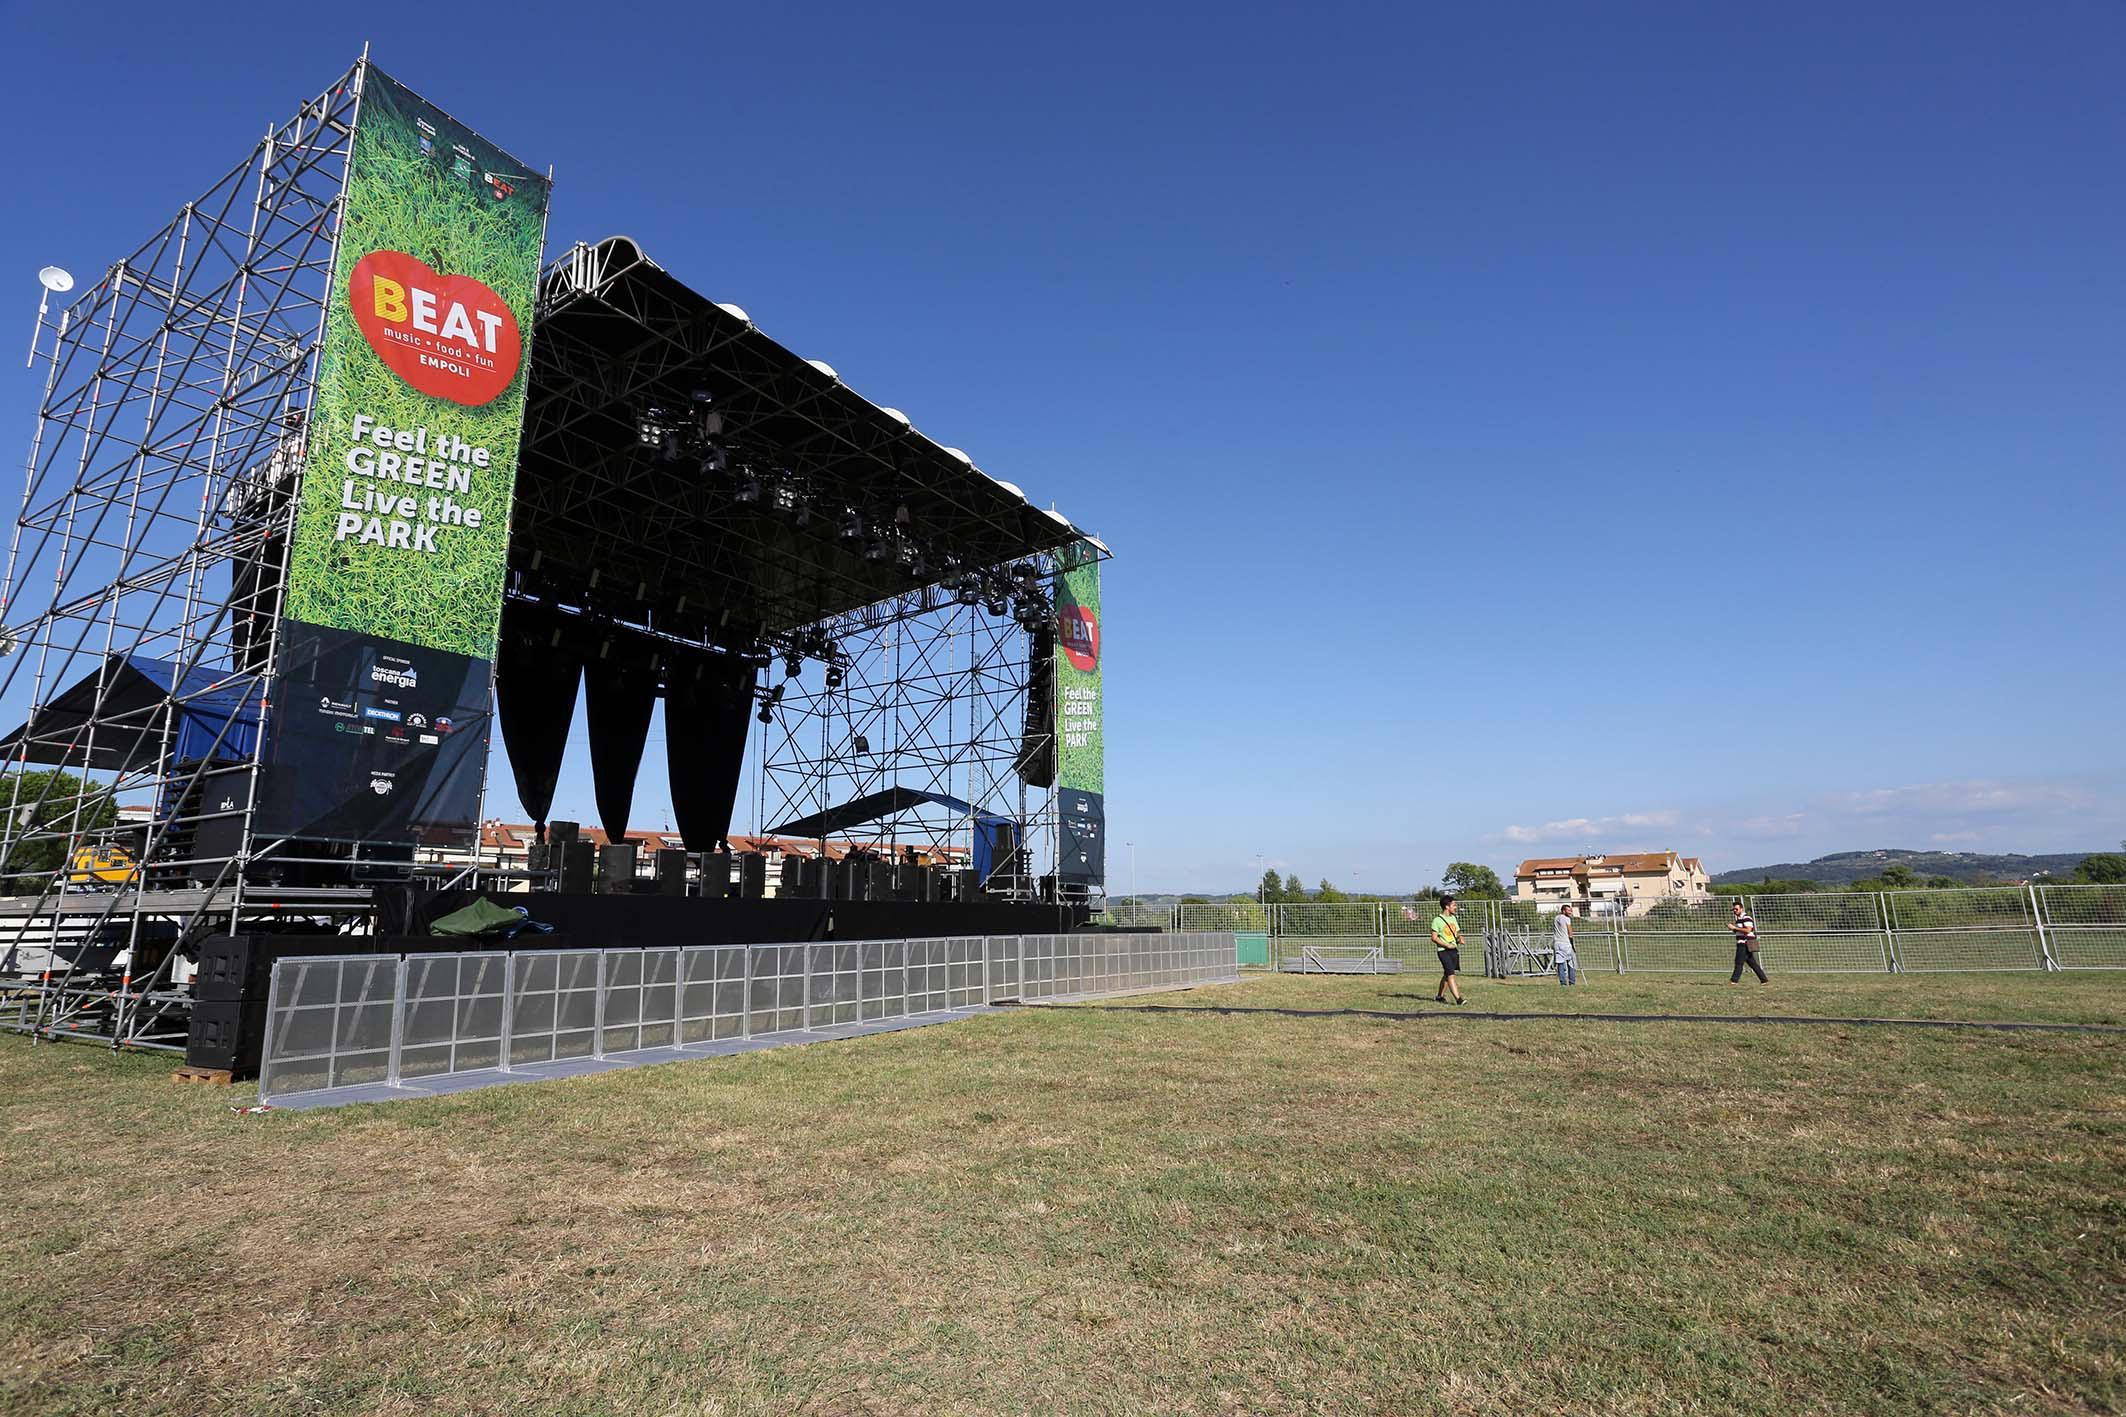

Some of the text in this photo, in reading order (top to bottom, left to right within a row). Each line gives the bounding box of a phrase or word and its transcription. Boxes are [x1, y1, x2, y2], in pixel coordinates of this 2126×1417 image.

[484, 172, 514, 196] BEAT
[372, 274, 503, 354] BEAT
[383, 326, 494, 368] music food fun
[419, 353, 470, 378] EMPOLI
[351, 414, 490, 467] Feel the
[346, 446, 472, 494] GREEN
[342, 479, 482, 528] Live the
[336, 512, 439, 553] PARK
[1064, 616, 1094, 643] BEAT
[371, 671, 417, 688] energia
[372, 665, 401, 676] toscana
[1064, 686, 1097, 700] Feel the
[1064, 701, 1093, 715] GREEN
[1064, 718, 1097, 732] Live the
[1065, 732, 1088, 748] PARK
